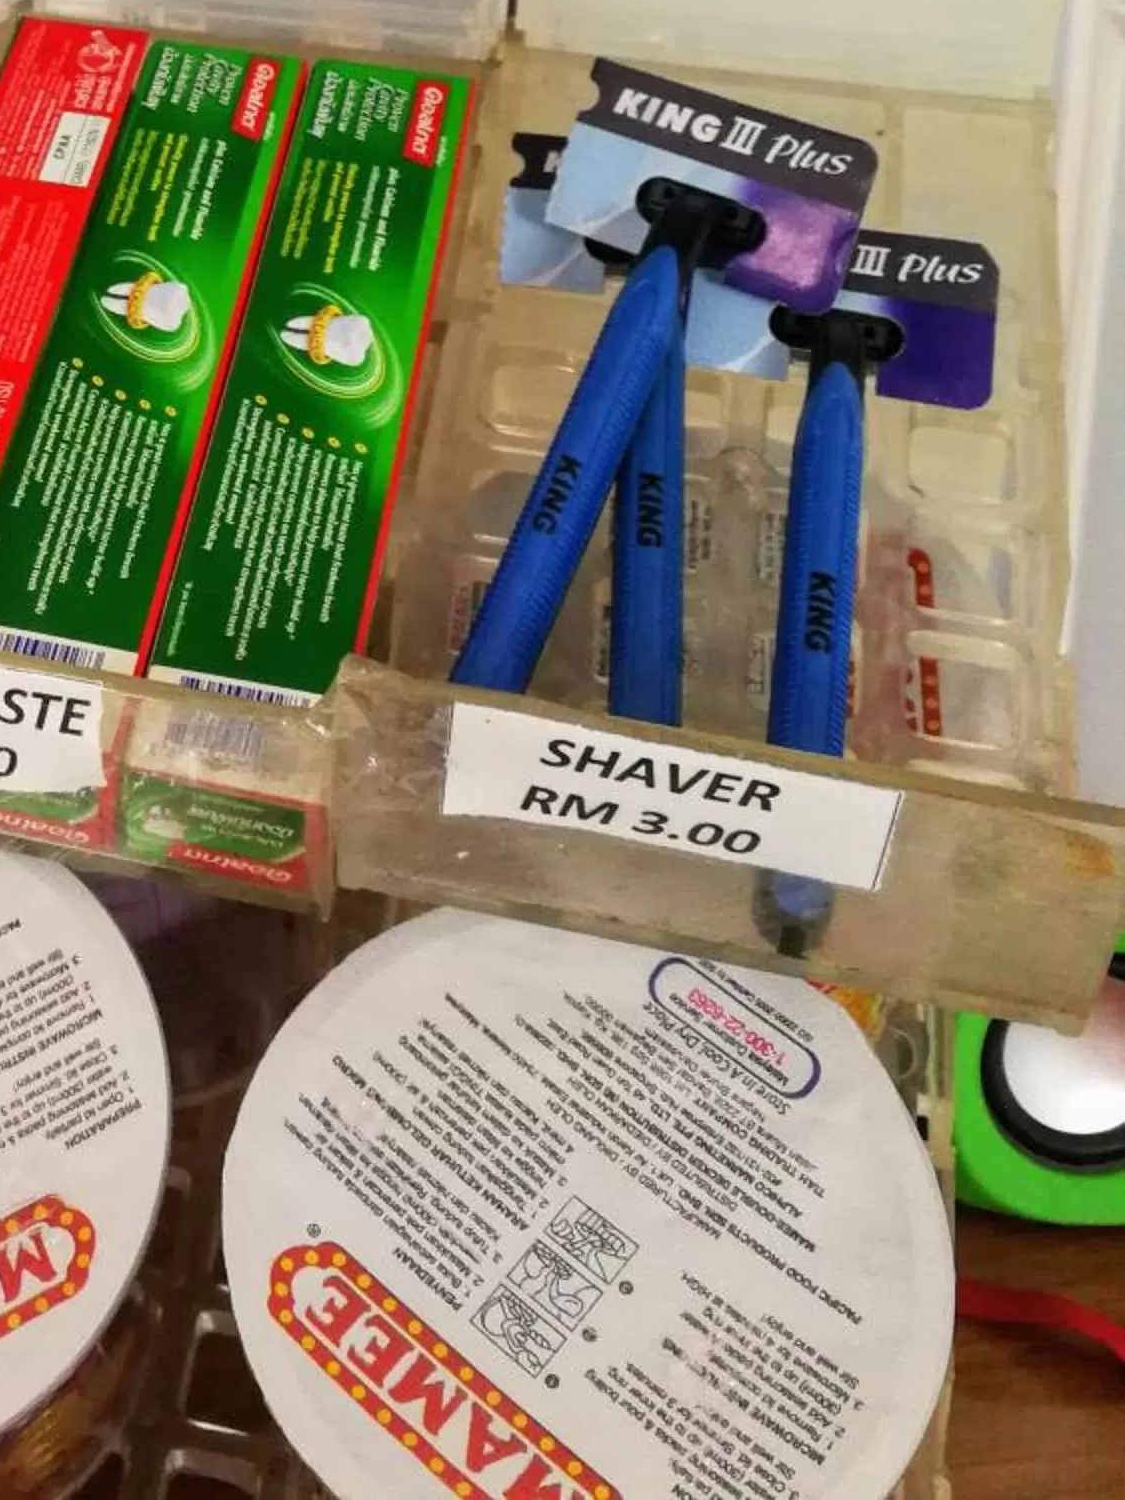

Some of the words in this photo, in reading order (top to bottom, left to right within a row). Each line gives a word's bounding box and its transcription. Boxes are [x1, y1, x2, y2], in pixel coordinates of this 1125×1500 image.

[188, 54, 213, 112] Protection
[219, 65, 241, 104] Proven
[356, 78, 380, 140] Protection
[389, 89, 407, 132] Proven
[613, 86, 720, 145] KING
[720, 116, 768, 157] III
[764, 132, 853, 177] Plus
[898, 253, 985, 285] Plus
[531, 453, 583, 537] KING
[634, 471, 665, 550] KING
[803, 570, 839, 654] KING
[539, 738, 781, 811] SHAVER
[520, 784, 619, 826] RM
[632, 811, 763, 854] 3.00
[643, 1002, 675, 1030] Place
[675, 1027, 699, 1048] Dry
[689, 990, 783, 1064] 1-300-22-6263
[698, 1042, 730, 1071] Cool,
[730, 1067, 744, 1078] A
[741, 1076, 756, 1091] In
[756, 1086, 790, 1114] Store
[695, 1136, 754, 1183] MARKETING
[727, 1224, 785, 1270] PRODUCTS
[786, 1268, 818, 1293] FOOD
[819, 1290, 861, 1324] PACIFIC
[752, 1408, 824, 1464] MICROWAVE
